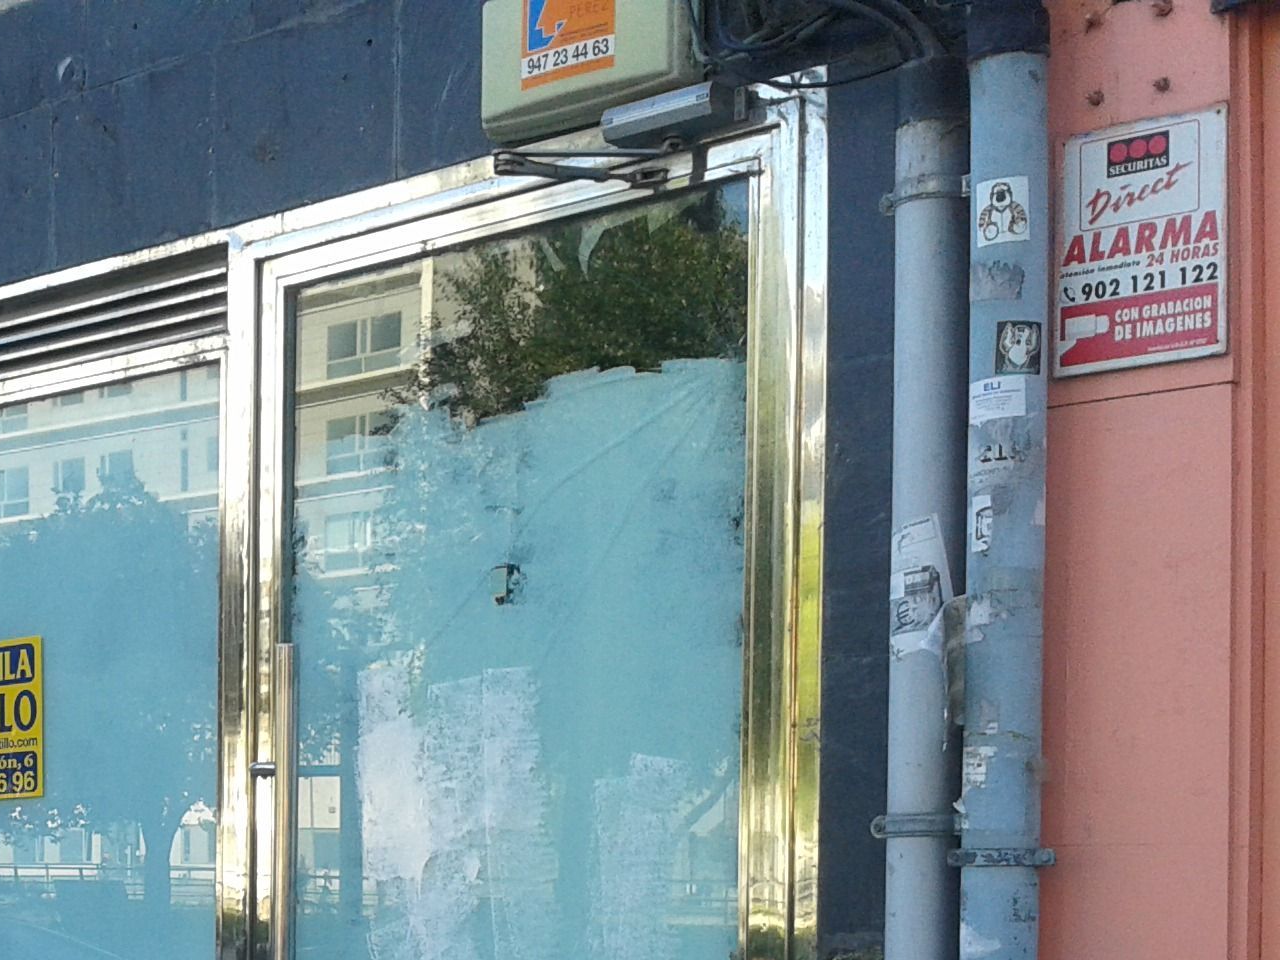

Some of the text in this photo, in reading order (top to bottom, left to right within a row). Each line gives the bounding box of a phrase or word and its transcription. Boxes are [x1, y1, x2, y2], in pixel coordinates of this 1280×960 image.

[527, 37, 610, 75] 947 23 44 63
[1108, 155, 1168, 177] SECURITAS
[1085, 160, 1194, 226] Direct
[1061, 209, 1220, 268] ALARMA
[1145, 253, 1165, 269] 24
[1170, 242, 1220, 265] HORAS
[1081, 261, 1219, 302] 902 121 122
[1114, 306, 1140, 323] CON
[1114, 311, 1212, 342] DE IMAGENES
[23, 753, 34, 768] 6
[12, 770, 36, 792] 96
